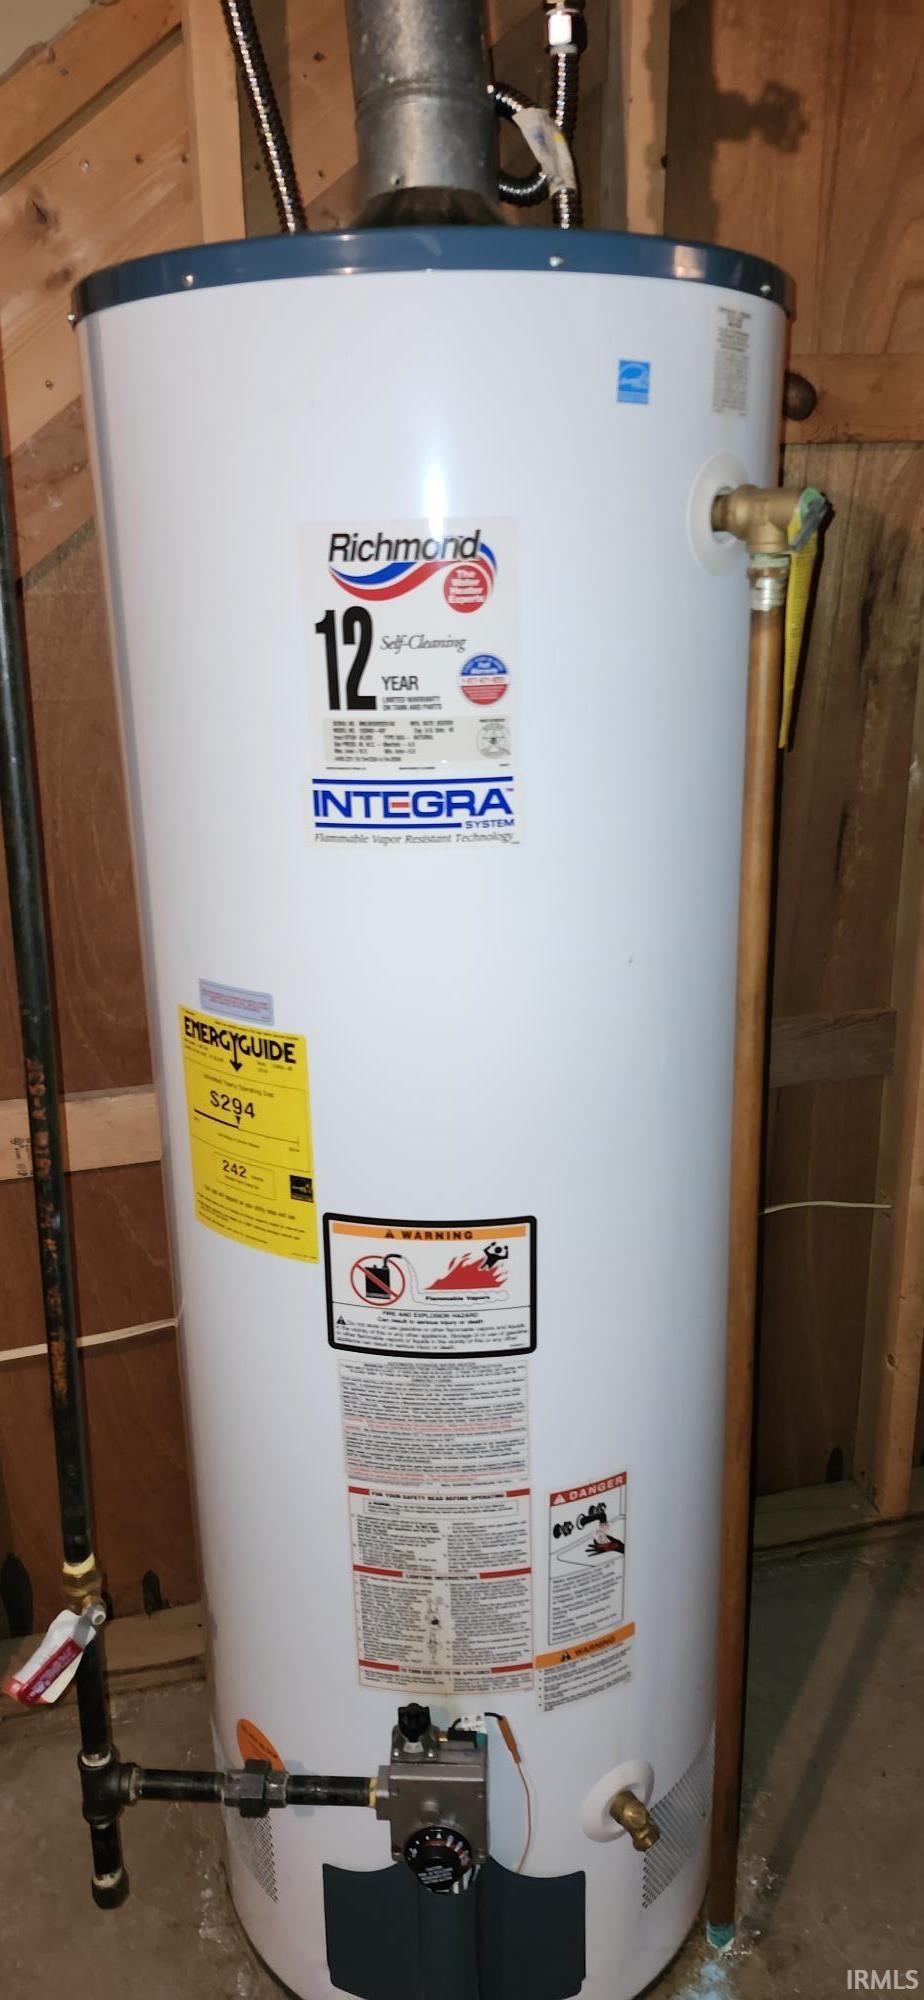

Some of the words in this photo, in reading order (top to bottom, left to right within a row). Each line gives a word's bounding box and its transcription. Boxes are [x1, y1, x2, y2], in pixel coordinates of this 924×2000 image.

[329, 529, 480, 562] Richmond
[456, 570, 476, 578] The
[380, 634, 466, 654] Self-Cleaning
[315, 606, 376, 710] 12
[381, 676, 418, 690] YEAR
[312, 789, 513, 818] INTEGRA
[465, 819, 514, 828] SYSTEM
[315, 833, 369, 843] Flammable
[372, 835, 402, 845] Vapor
[406, 834, 450, 844] Resistant
[456, 832, 513, 844] Technology
[184, 1016, 296, 1064] ENERGYGUIDE
[210, 1090, 255, 1118] $294
[222, 1160, 247, 1178] 242
[402, 1231, 473, 1240] WARNING
[569, 1476, 624, 1500] DANGER
[574, 1634, 616, 1656] WARNING
